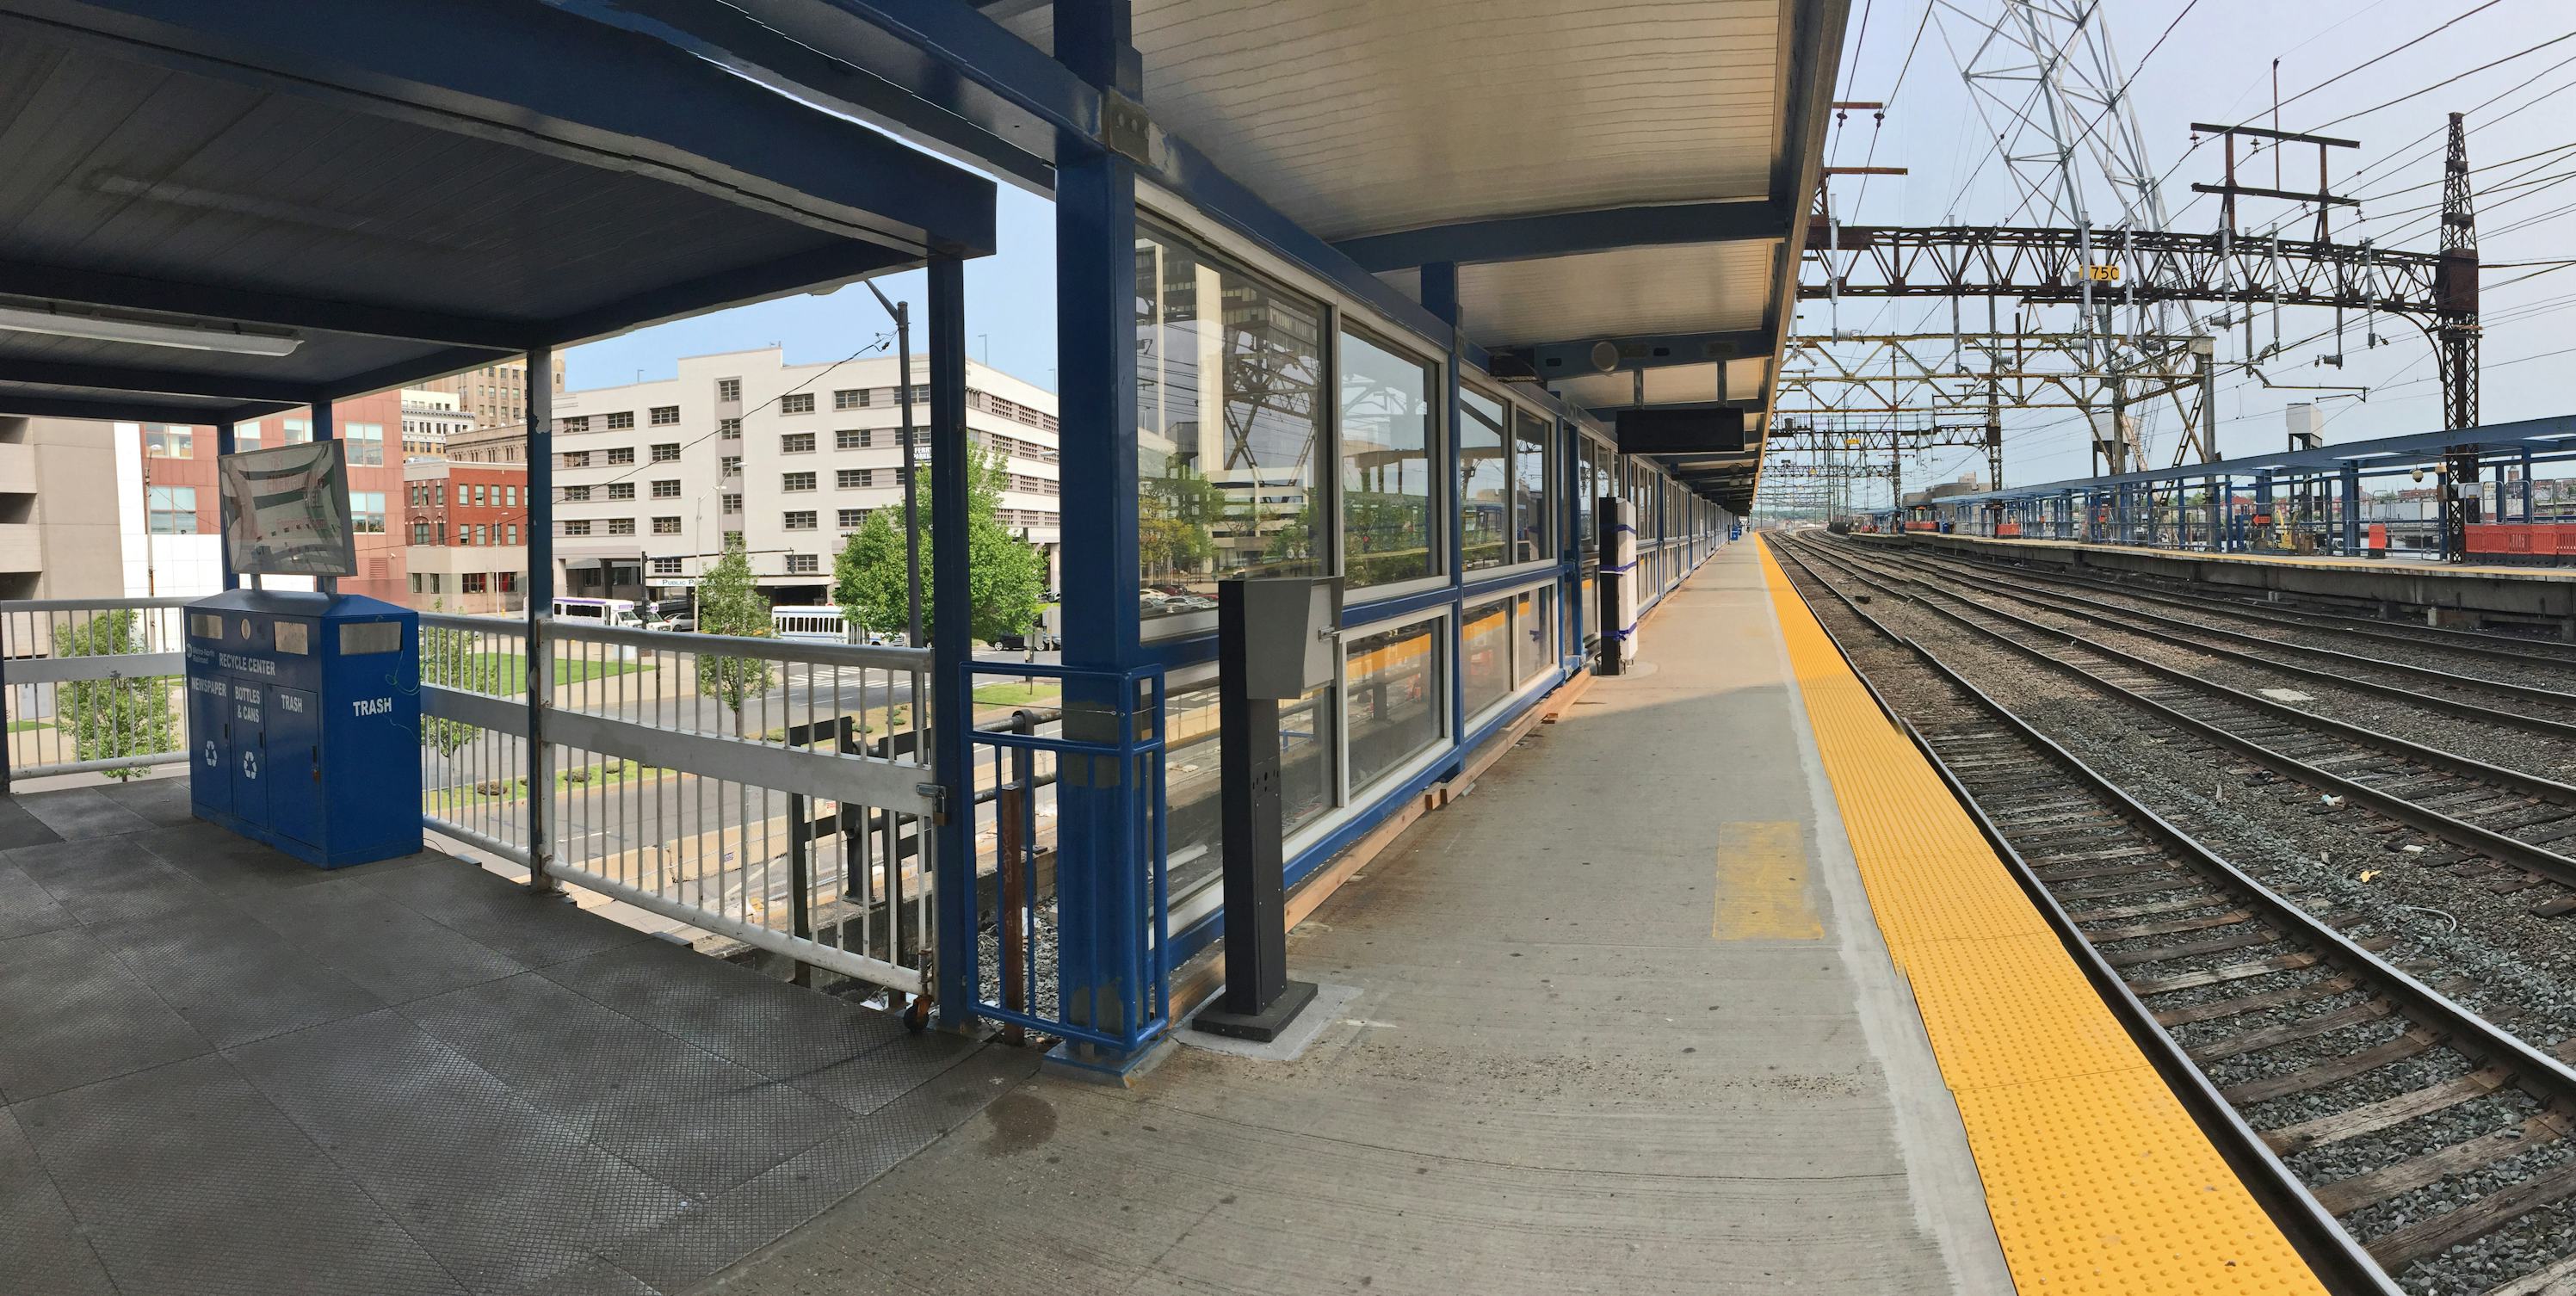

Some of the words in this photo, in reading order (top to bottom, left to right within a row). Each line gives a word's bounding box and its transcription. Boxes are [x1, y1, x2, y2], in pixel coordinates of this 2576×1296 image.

[219, 652, 248, 671] RECYCLE
[248, 657, 275, 676] CENTER
[191, 676, 227, 698] NEWSPAPER
[234, 685, 261, 705] BOTTLES
[281, 694, 304, 713] TRASH
[353, 697, 392, 717] TRASH
[237, 704, 242, 719] &
[243, 706, 260, 724] CANS
